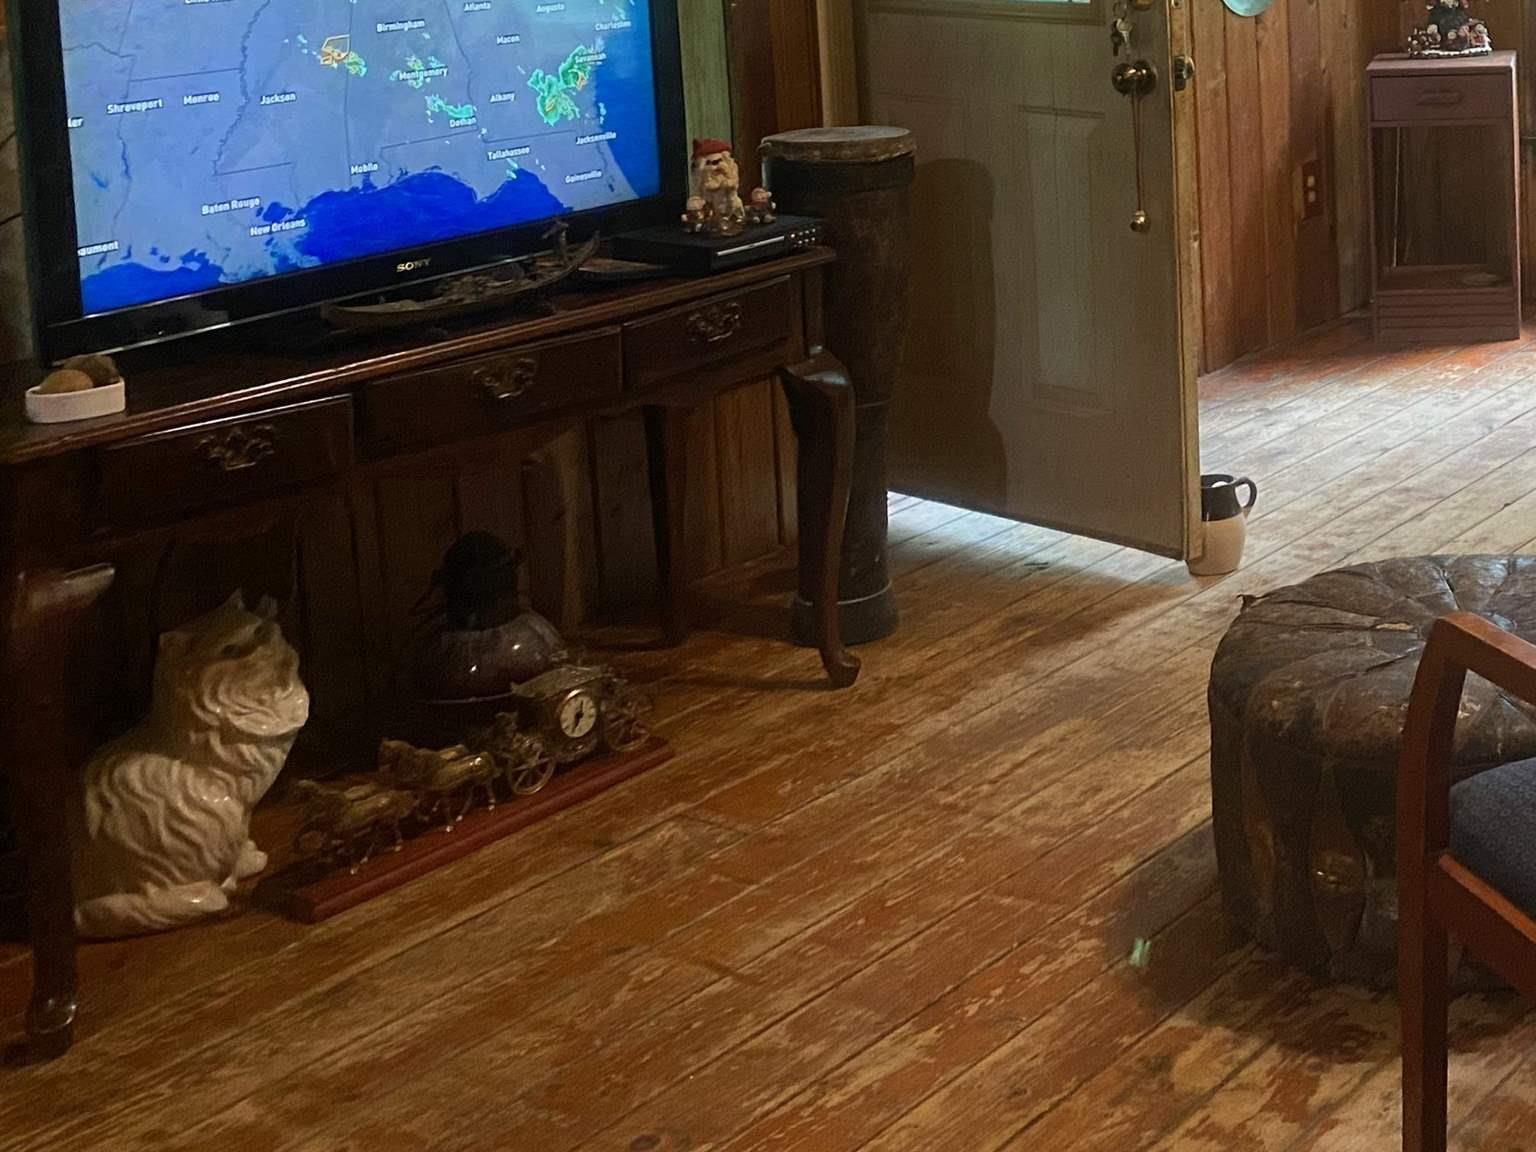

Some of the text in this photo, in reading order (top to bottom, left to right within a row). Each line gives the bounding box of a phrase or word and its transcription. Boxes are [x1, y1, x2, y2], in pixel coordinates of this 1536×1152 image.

[464, 1, 491, 11] Atlanta
[376, 19, 425, 33] Birmingham
[496, 34, 520, 45] Macon
[399, 66, 449, 81] Montgomery
[183, 92, 220, 105] Monroe
[259, 92, 297, 105] Jackson
[489, 92, 516, 103] Albany
[106, 99, 163, 115] Shreveport
[449, 116, 477, 127] Dothan
[576, 132, 617, 145] Jacksonville
[487, 147, 530, 160] Tallahassee
[350, 163, 379, 174] Mobile
[201, 197, 261, 215] Baton Rouge
[250, 218, 306, 236] New Orleans
[396, 258, 431, 273] SONY
